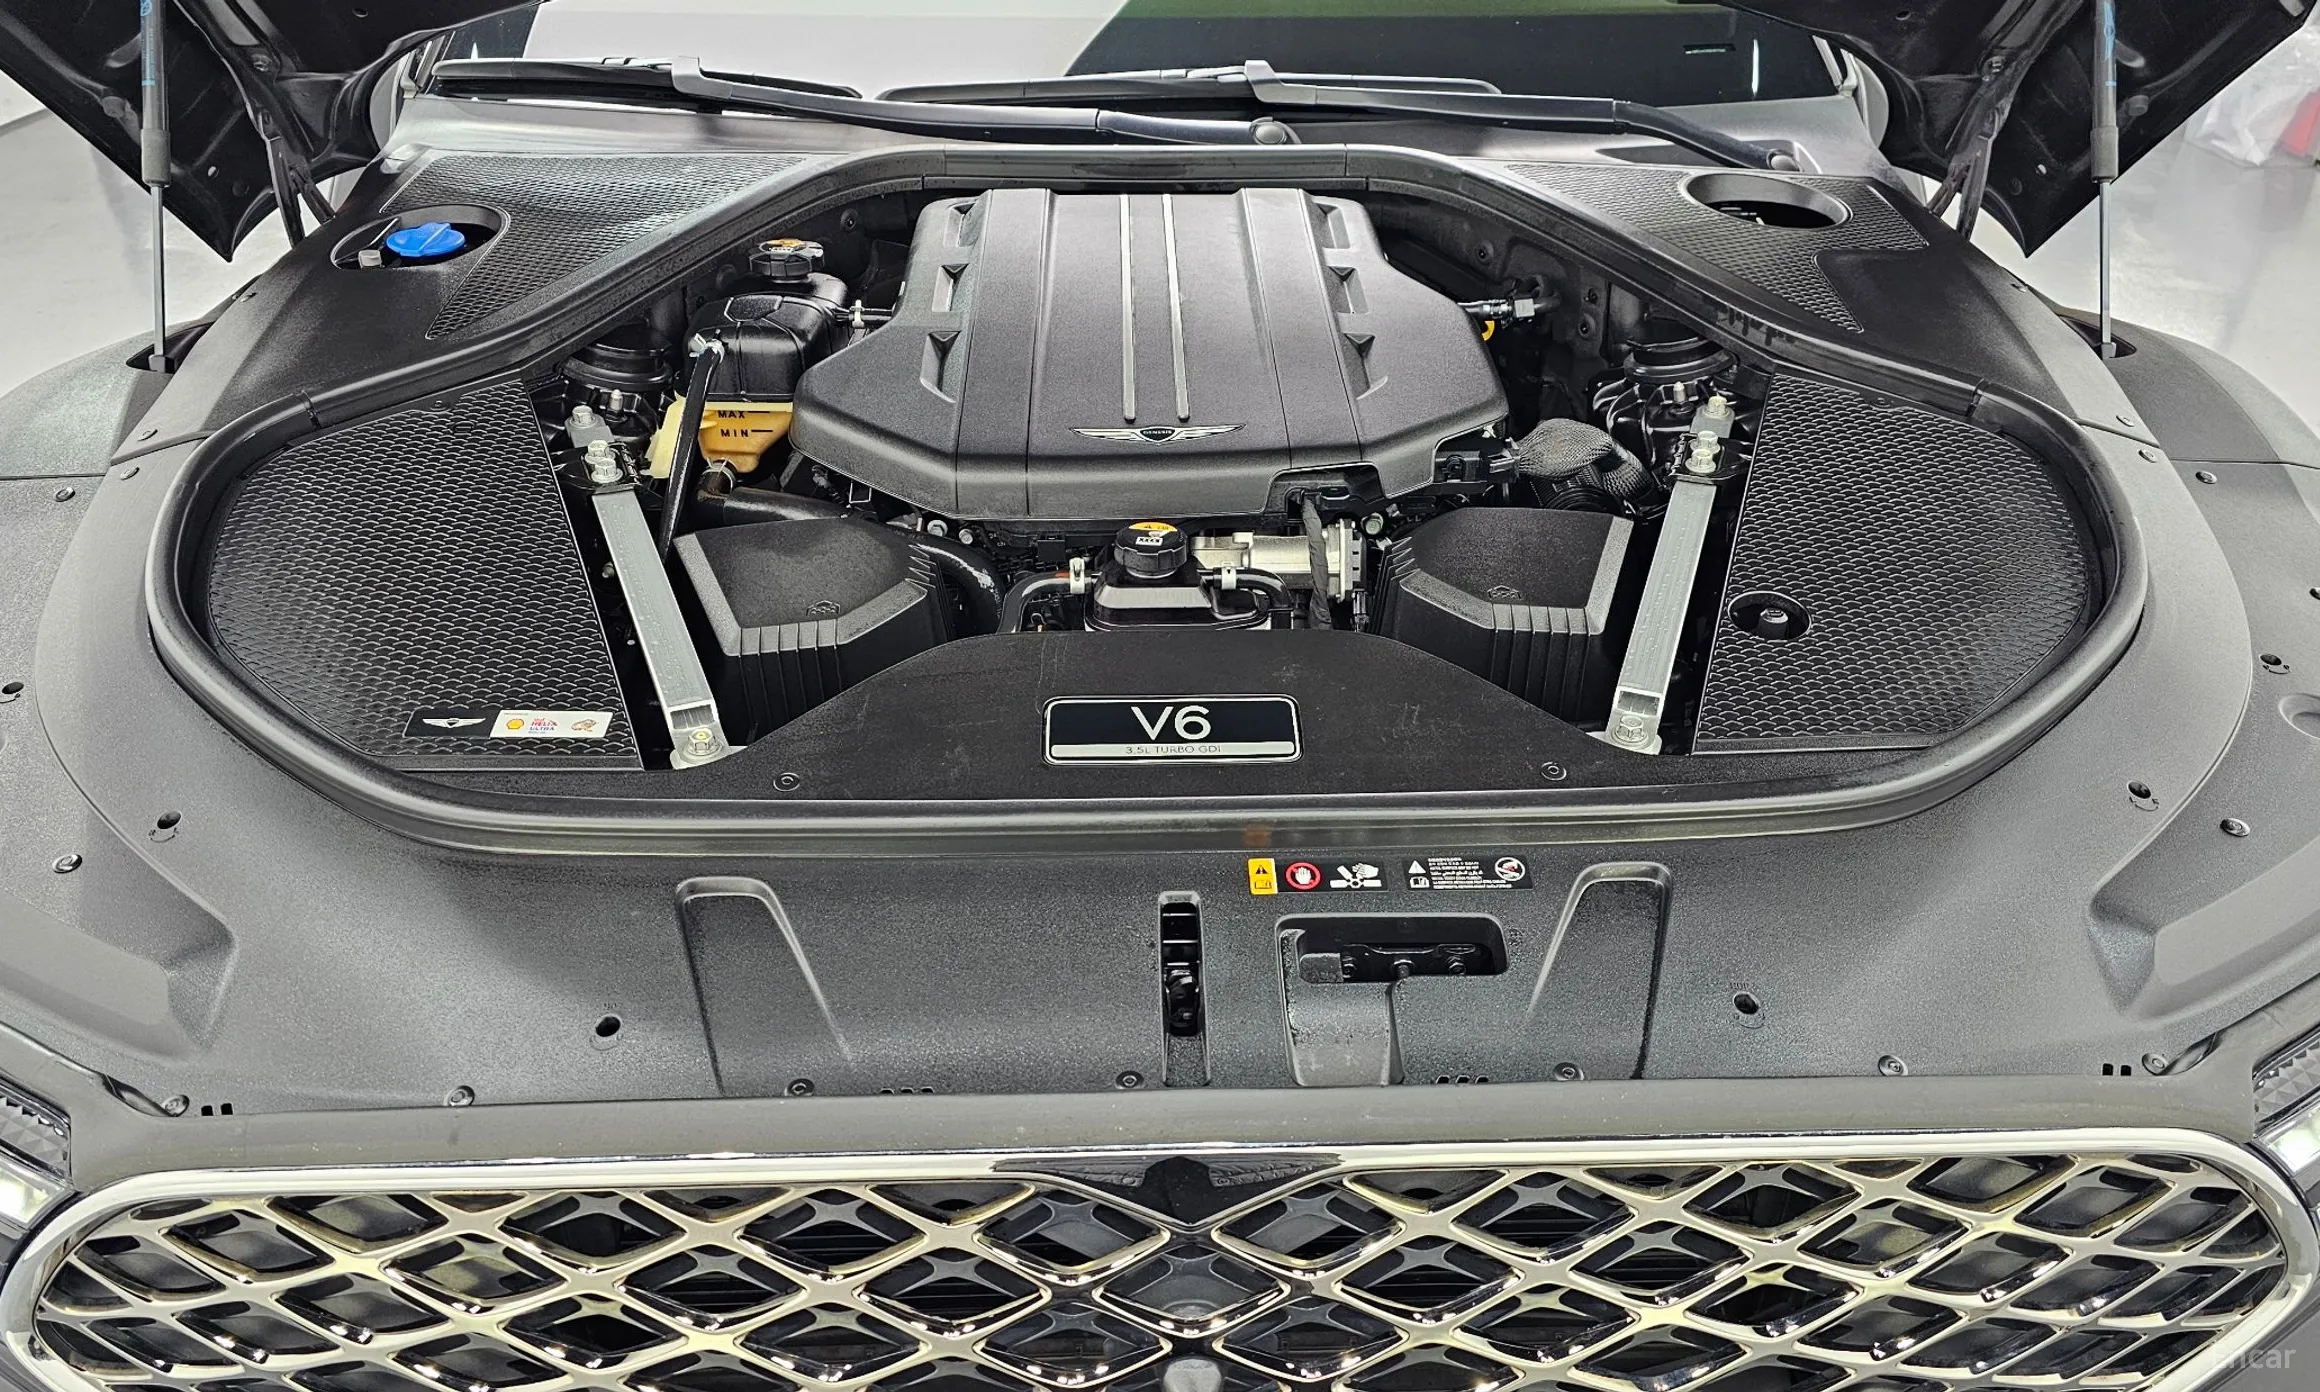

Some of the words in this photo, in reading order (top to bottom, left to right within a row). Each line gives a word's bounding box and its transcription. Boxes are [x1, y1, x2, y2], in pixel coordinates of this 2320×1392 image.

[718, 410, 745, 418] MAX
[721, 429, 748, 437] MIN
[1131, 705, 1211, 740] V6
[1125, 746, 1150, 754] 3.5L
[1155, 745, 1194, 753] TURBO
